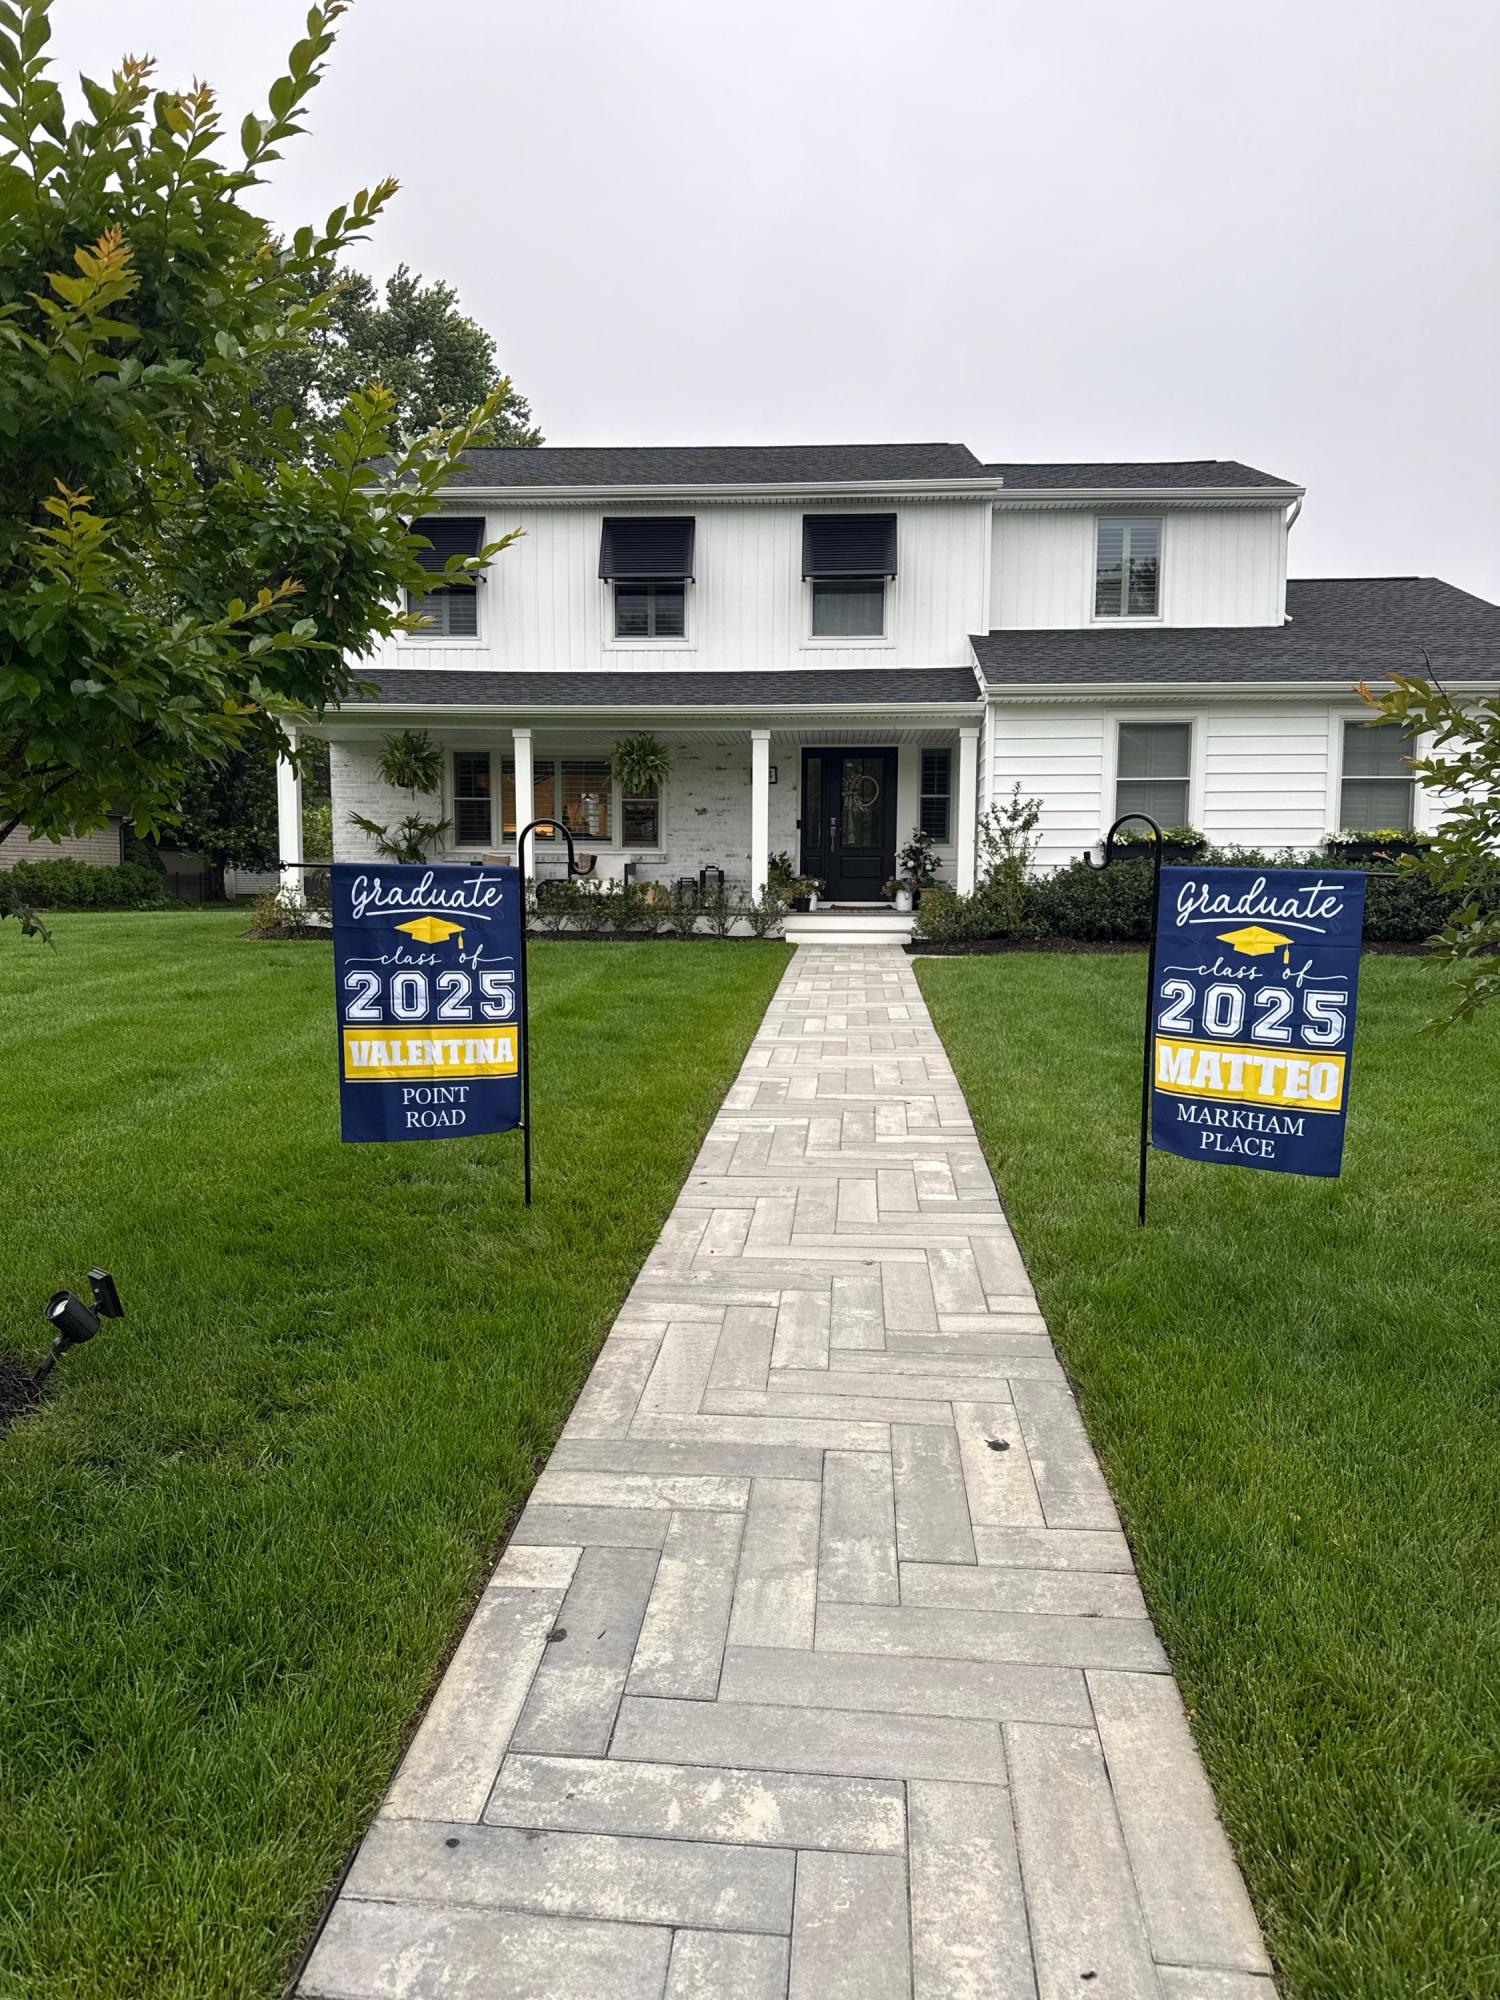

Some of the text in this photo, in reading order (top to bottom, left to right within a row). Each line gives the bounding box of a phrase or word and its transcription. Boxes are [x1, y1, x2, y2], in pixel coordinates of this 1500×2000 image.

[345, 944, 514, 970] class of
[1163, 957, 1348, 988] class of
[344, 970, 515, 1021] 2025
[1158, 979, 1348, 1046] 2025
[348, 1039, 514, 1067] VALENTINA
[1158, 1045, 1339, 1102] MATTEO
[402, 1087, 469, 1105] POINT
[406, 1110, 466, 1128] ROAD
[1176, 1103, 1305, 1136] MARKHAM
[1200, 1132, 1275, 1159] PLACE
